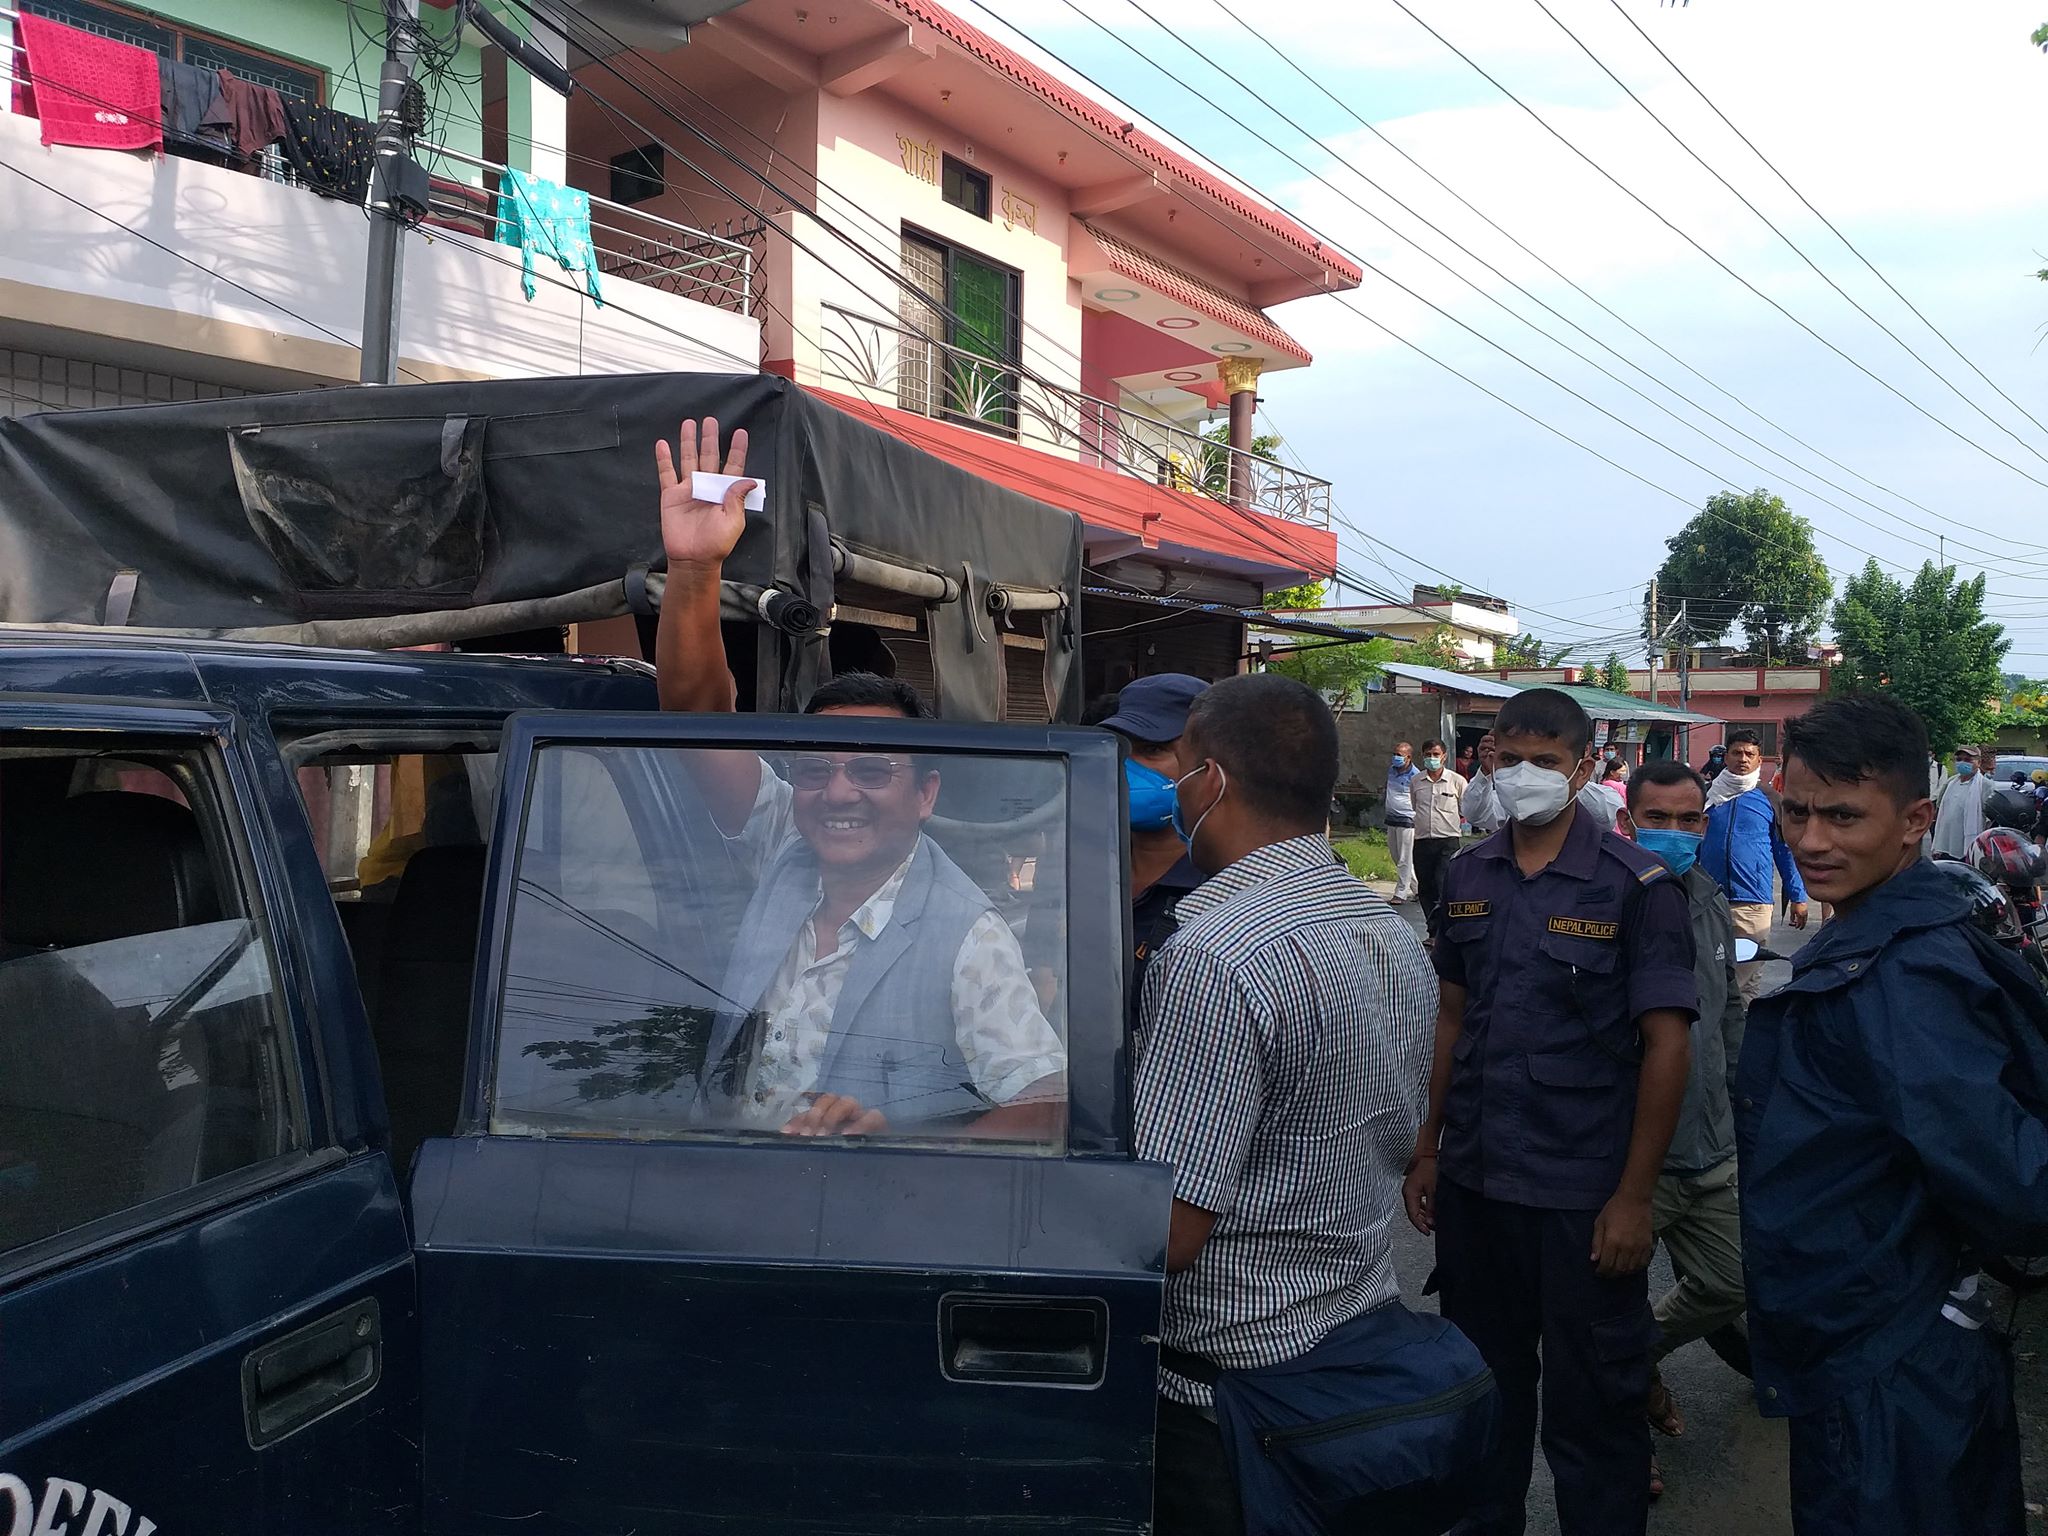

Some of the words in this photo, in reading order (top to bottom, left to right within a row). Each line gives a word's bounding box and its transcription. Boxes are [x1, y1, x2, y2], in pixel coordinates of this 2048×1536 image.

[1464, 903, 1485, 914] PANT
[1552, 919, 1584, 933] NEPAL
[1584, 922, 1616, 936] POLICE
